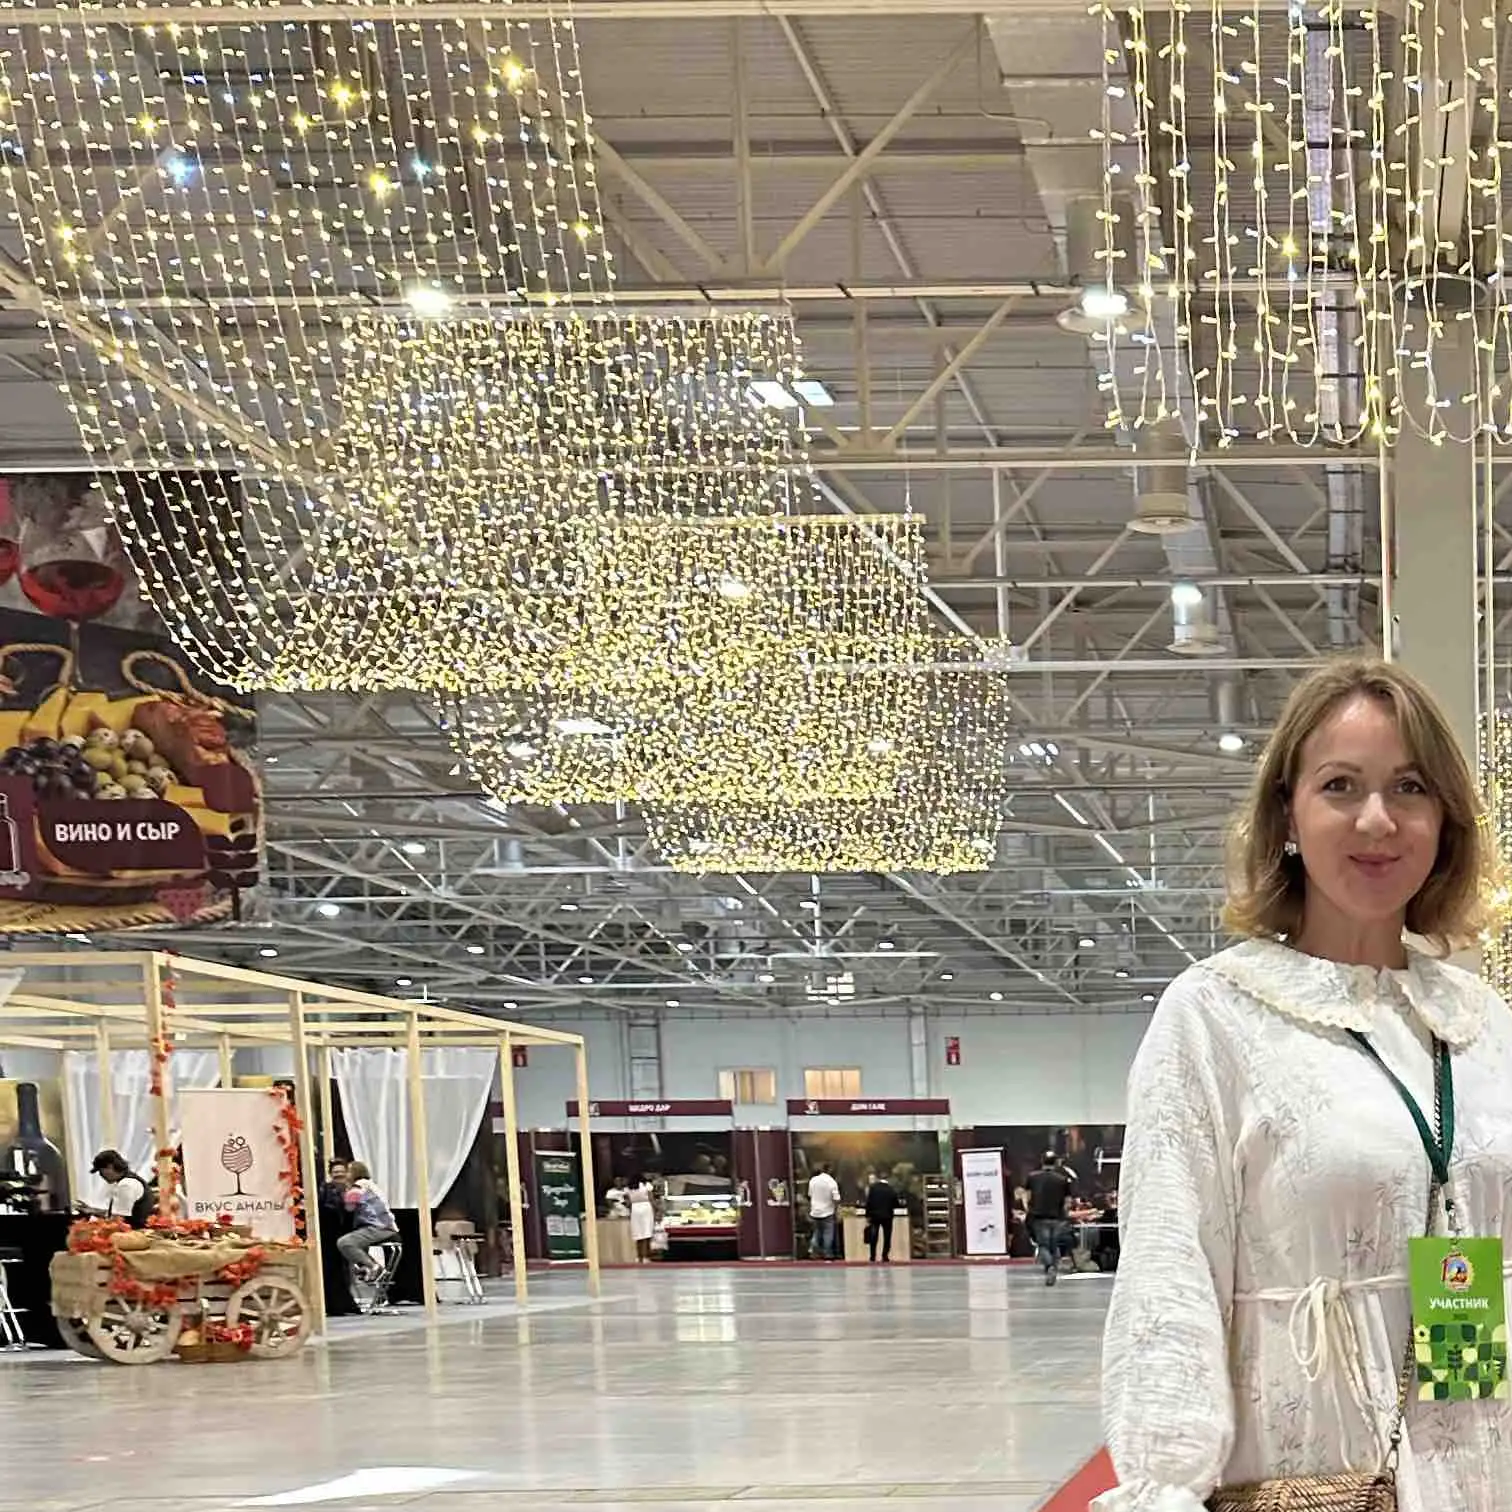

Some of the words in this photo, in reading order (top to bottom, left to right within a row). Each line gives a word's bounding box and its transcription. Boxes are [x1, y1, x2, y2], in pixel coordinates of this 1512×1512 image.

[55, 824, 112, 842] ВИНО
[117, 823, 131, 840] И
[136, 822, 180, 840] СЫР
[195, 1201, 233, 1213] ВКУС
[236, 1201, 285, 1212] АНАПЫ
[1429, 1298, 1489, 1311] УЧАСТНИК
